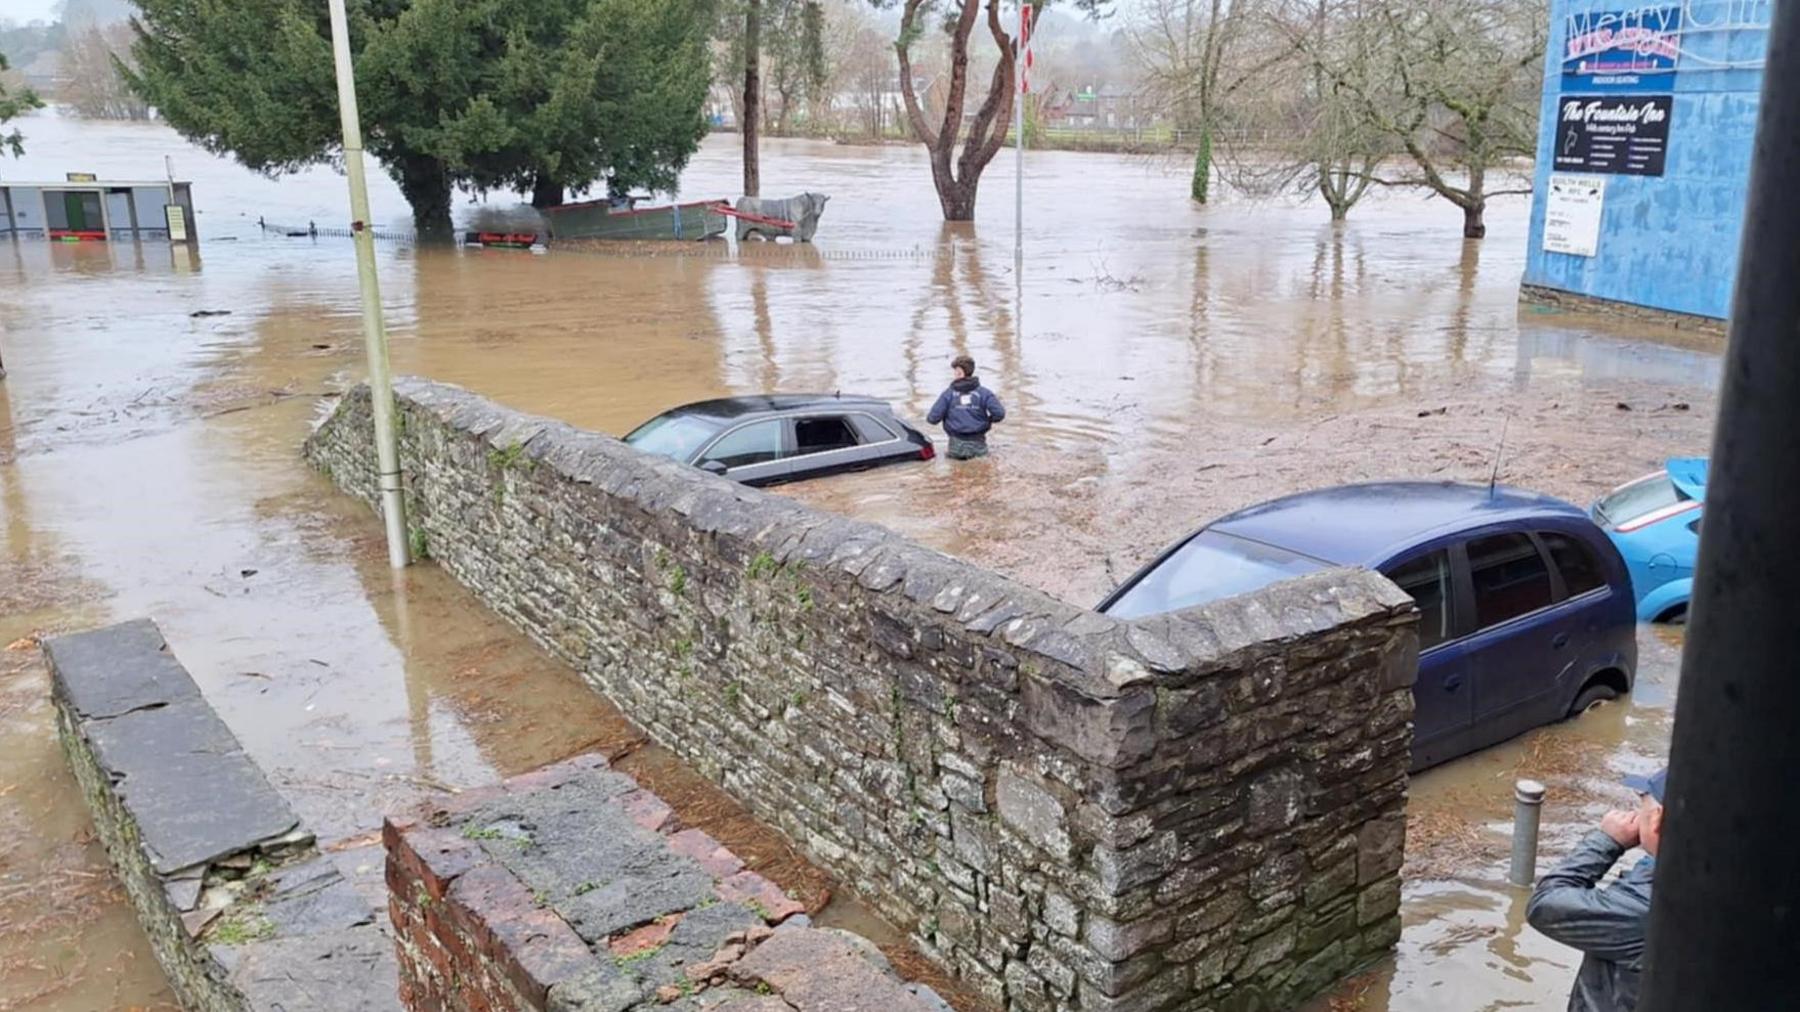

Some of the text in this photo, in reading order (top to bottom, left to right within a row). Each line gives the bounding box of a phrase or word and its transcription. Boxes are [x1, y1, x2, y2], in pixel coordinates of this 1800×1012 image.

[1566, 3, 1674, 50] Merry
[1563, 100, 1666, 124] The Fountain Inn
[1578, 179, 1600, 188] WELLS
